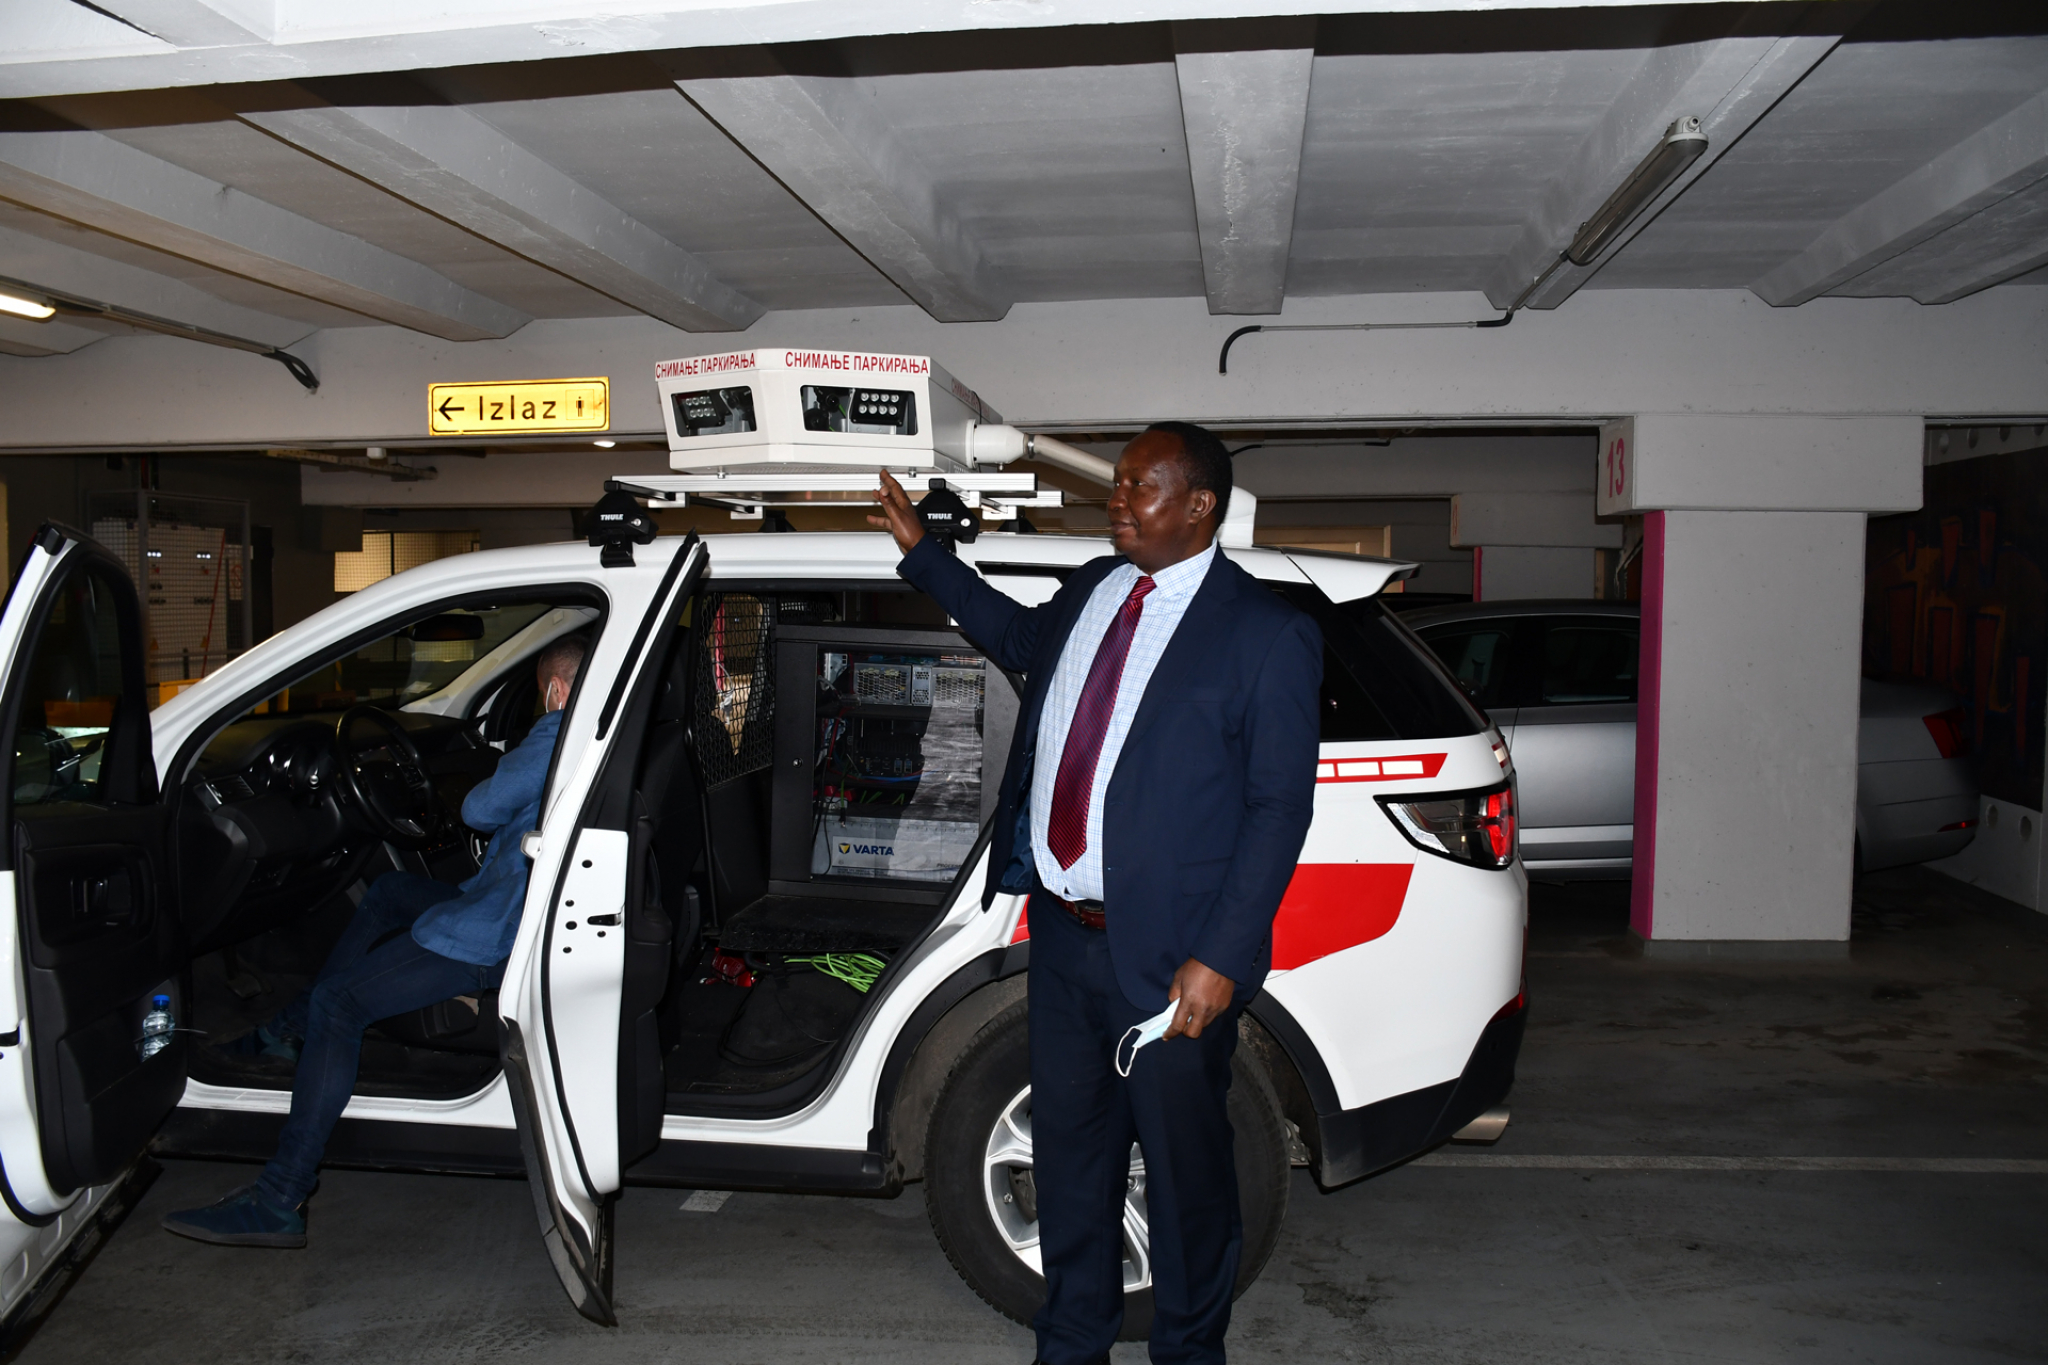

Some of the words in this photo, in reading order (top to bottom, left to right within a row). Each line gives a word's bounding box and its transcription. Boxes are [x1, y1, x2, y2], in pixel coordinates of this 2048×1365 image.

[655, 359, 699, 379] СНИМАЊЕ
[700, 352, 756, 374] ПАРКИРАЊА
[785, 351, 850, 370] СНИМАЊЕ
[853, 355, 929, 374] ПАРКИРАЊА
[478, 394, 557, 421] Izlaz
[1606, 437, 1625, 498] 13
[600, 513, 625, 521] THULE
[853, 844, 895, 856] VARTA
